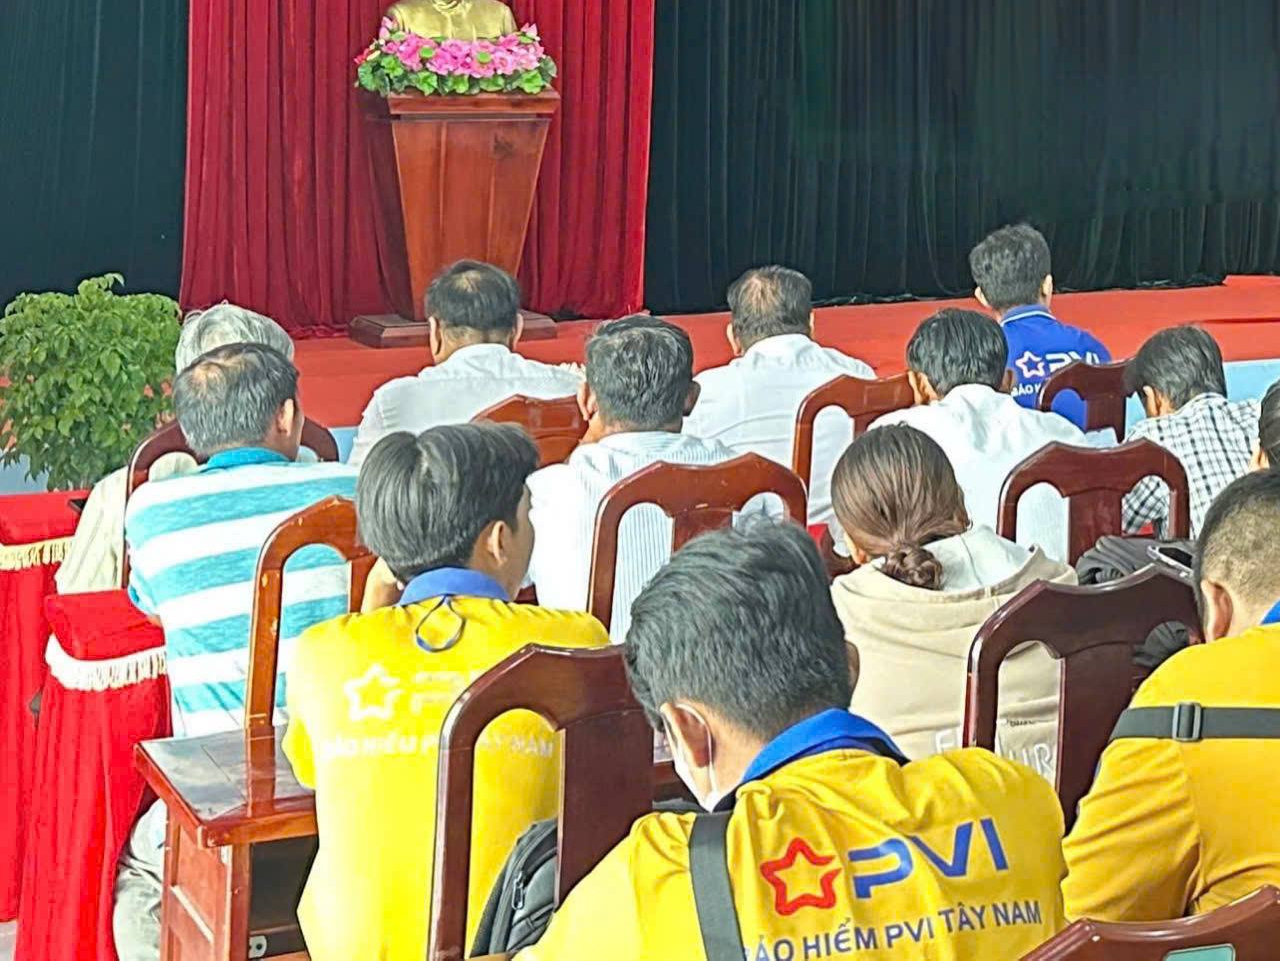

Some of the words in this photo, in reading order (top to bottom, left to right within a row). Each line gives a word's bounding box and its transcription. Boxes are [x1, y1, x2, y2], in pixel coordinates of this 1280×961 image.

[847, 818, 1009, 900] PVI
[802, 917, 878, 960] HIỂM
[885, 918, 935, 949] PVI
[938, 901, 986, 933] TÂY
[990, 901, 1042, 928] NAM
